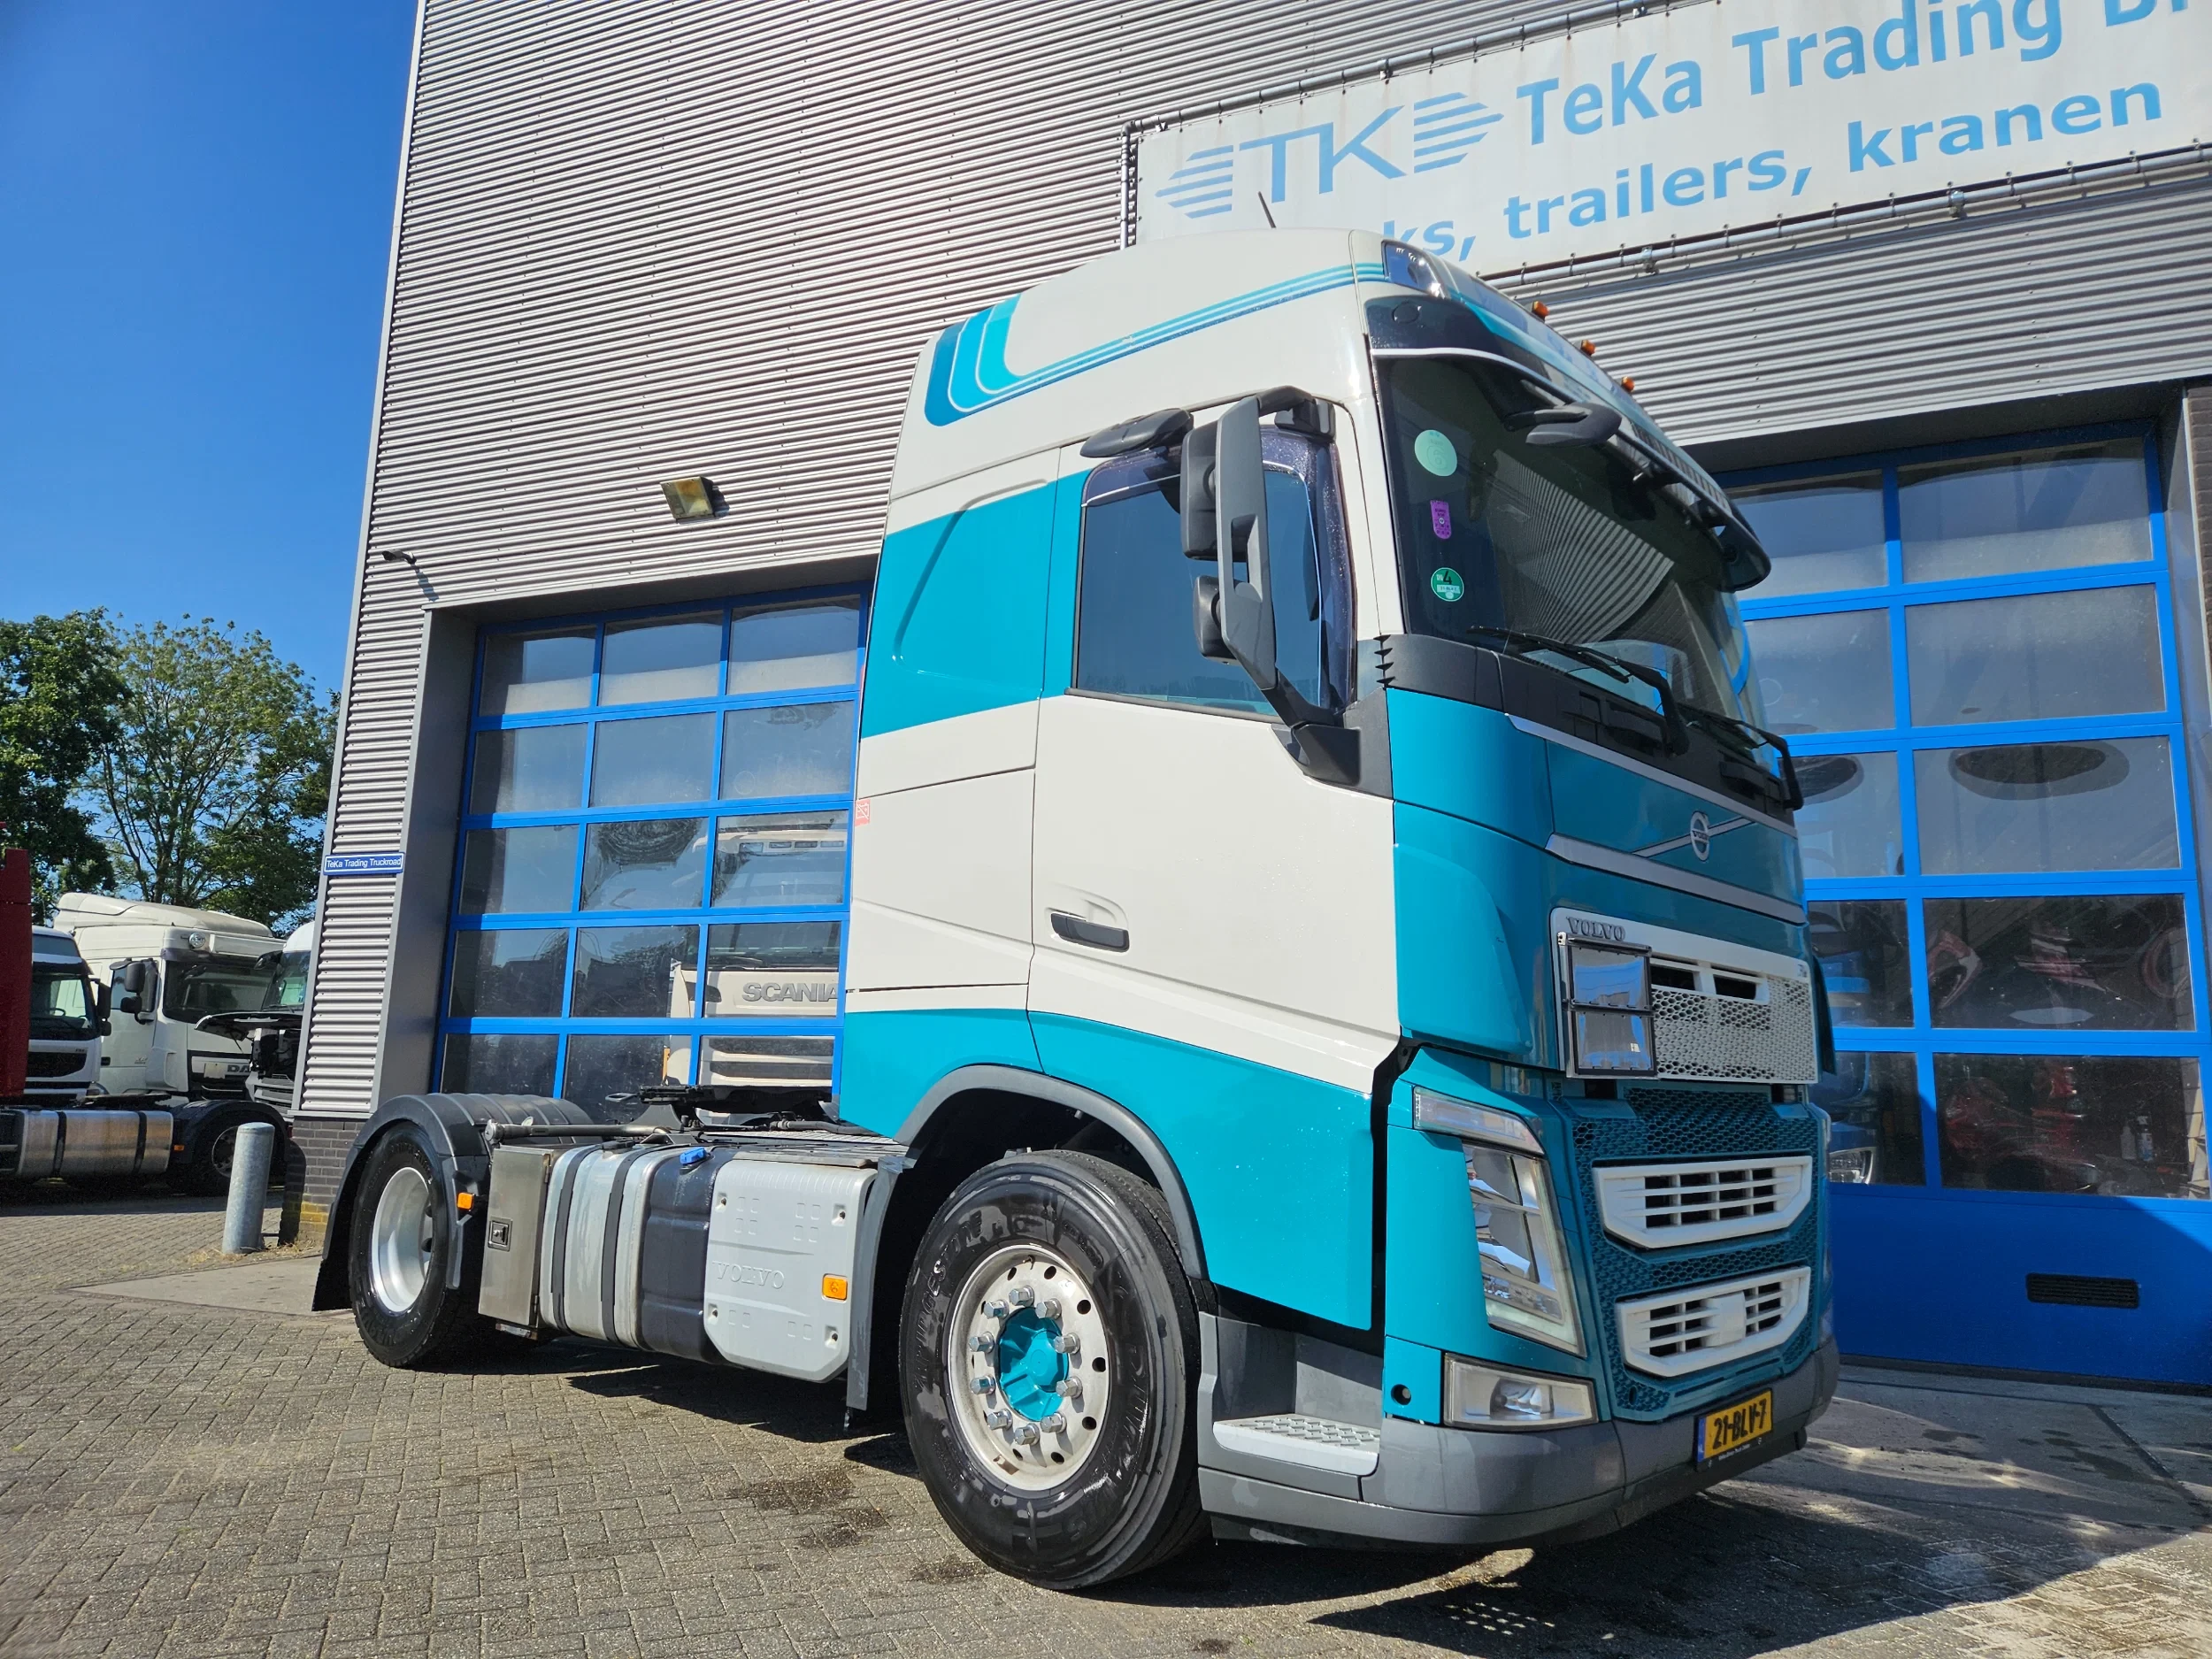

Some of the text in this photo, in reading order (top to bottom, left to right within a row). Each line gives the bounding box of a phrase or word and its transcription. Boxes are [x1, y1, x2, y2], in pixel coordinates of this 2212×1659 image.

[1516, 0, 2062, 145] TeKa Trading
[1504, 150, 1812, 239] trailers,
[1847, 81, 2162, 173] kranen
[1442, 570, 1453, 585] 4
[326, 856, 402, 869] TeKa Trading Truckroad
[1566, 916, 1626, 941] VOLVO
[711, 1260, 785, 1290] VOLVO
